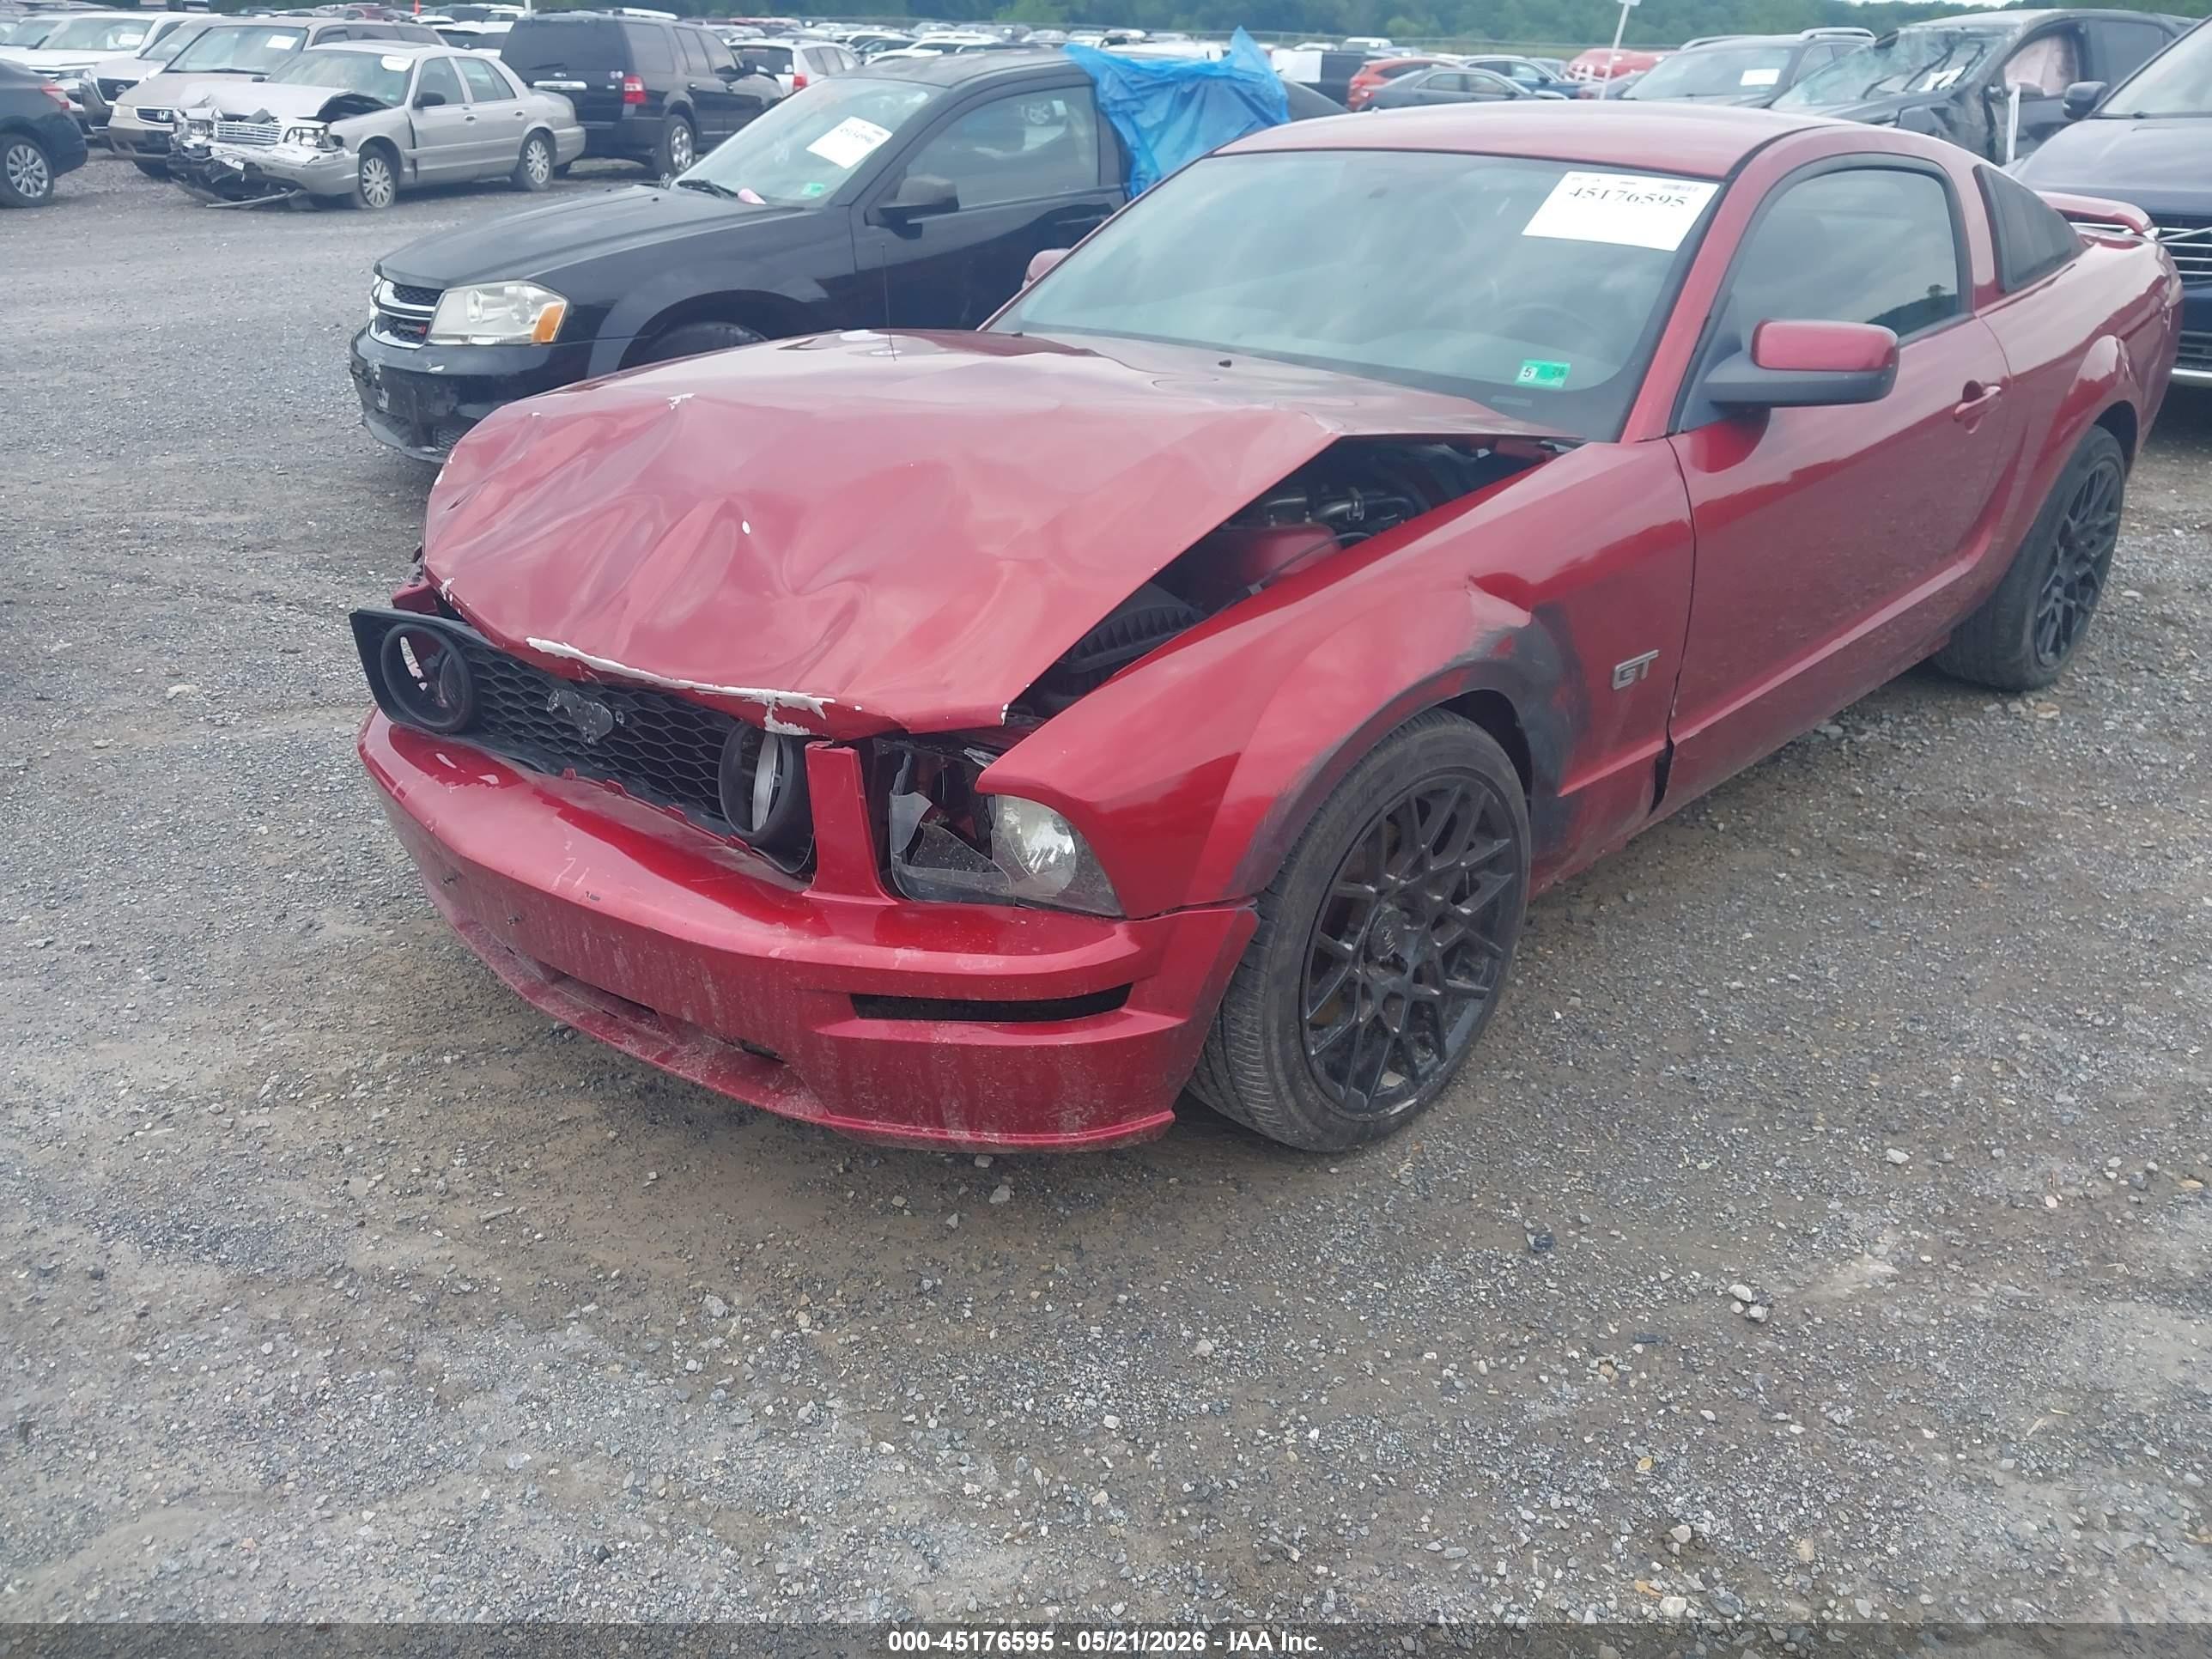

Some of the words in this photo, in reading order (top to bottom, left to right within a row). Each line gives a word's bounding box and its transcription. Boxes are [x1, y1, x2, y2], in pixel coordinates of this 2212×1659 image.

[1568, 186, 1689, 207] 45176595
[1522, 366, 1533, 378] 5
[1612, 648, 1660, 690] GT
